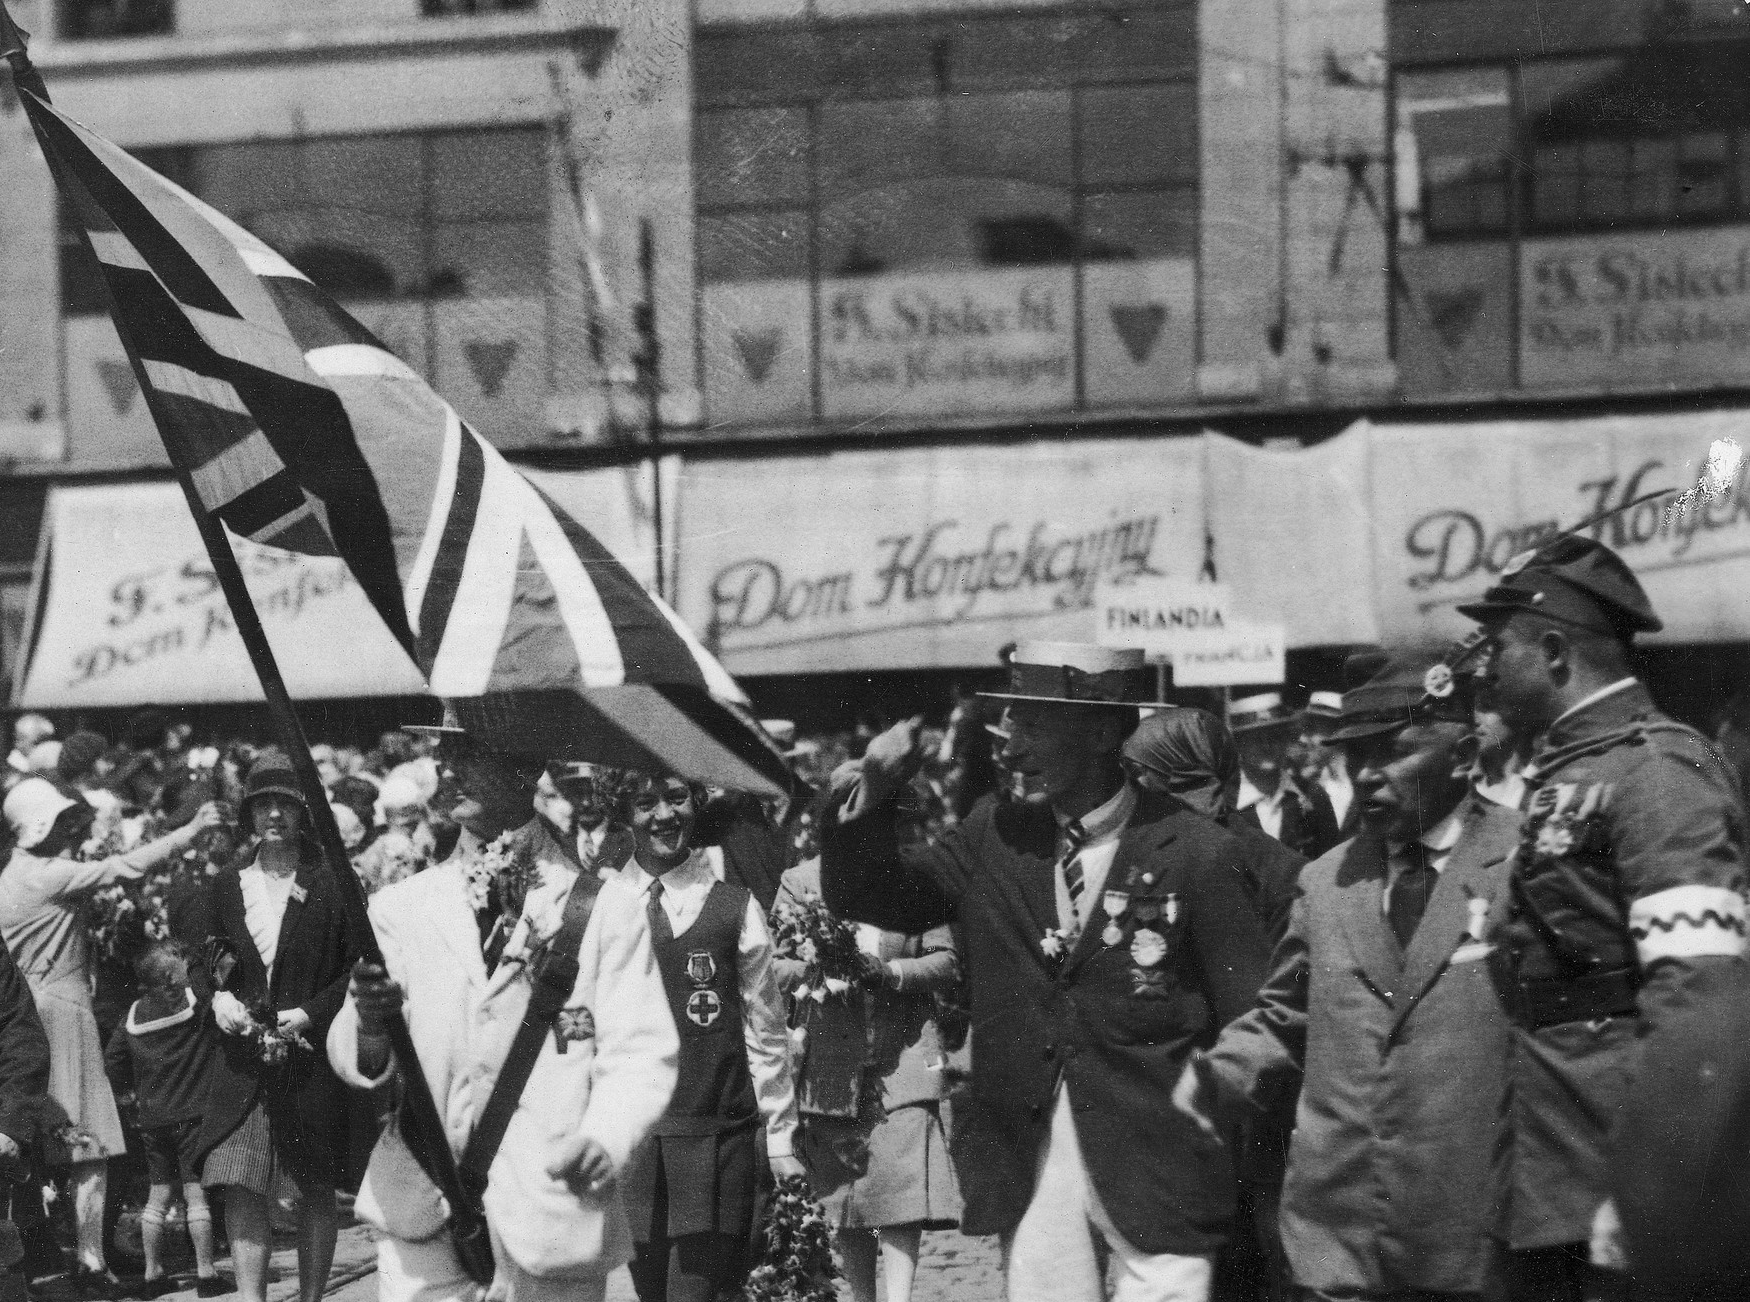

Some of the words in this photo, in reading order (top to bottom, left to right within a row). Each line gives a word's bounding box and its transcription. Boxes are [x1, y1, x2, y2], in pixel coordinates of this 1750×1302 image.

[708, 558, 853, 630] Dom
[867, 510, 1166, 612] Konfekcyjny
[1107, 606, 1225, 630] FINLANDIA
[65, 628, 186, 686] Dom
